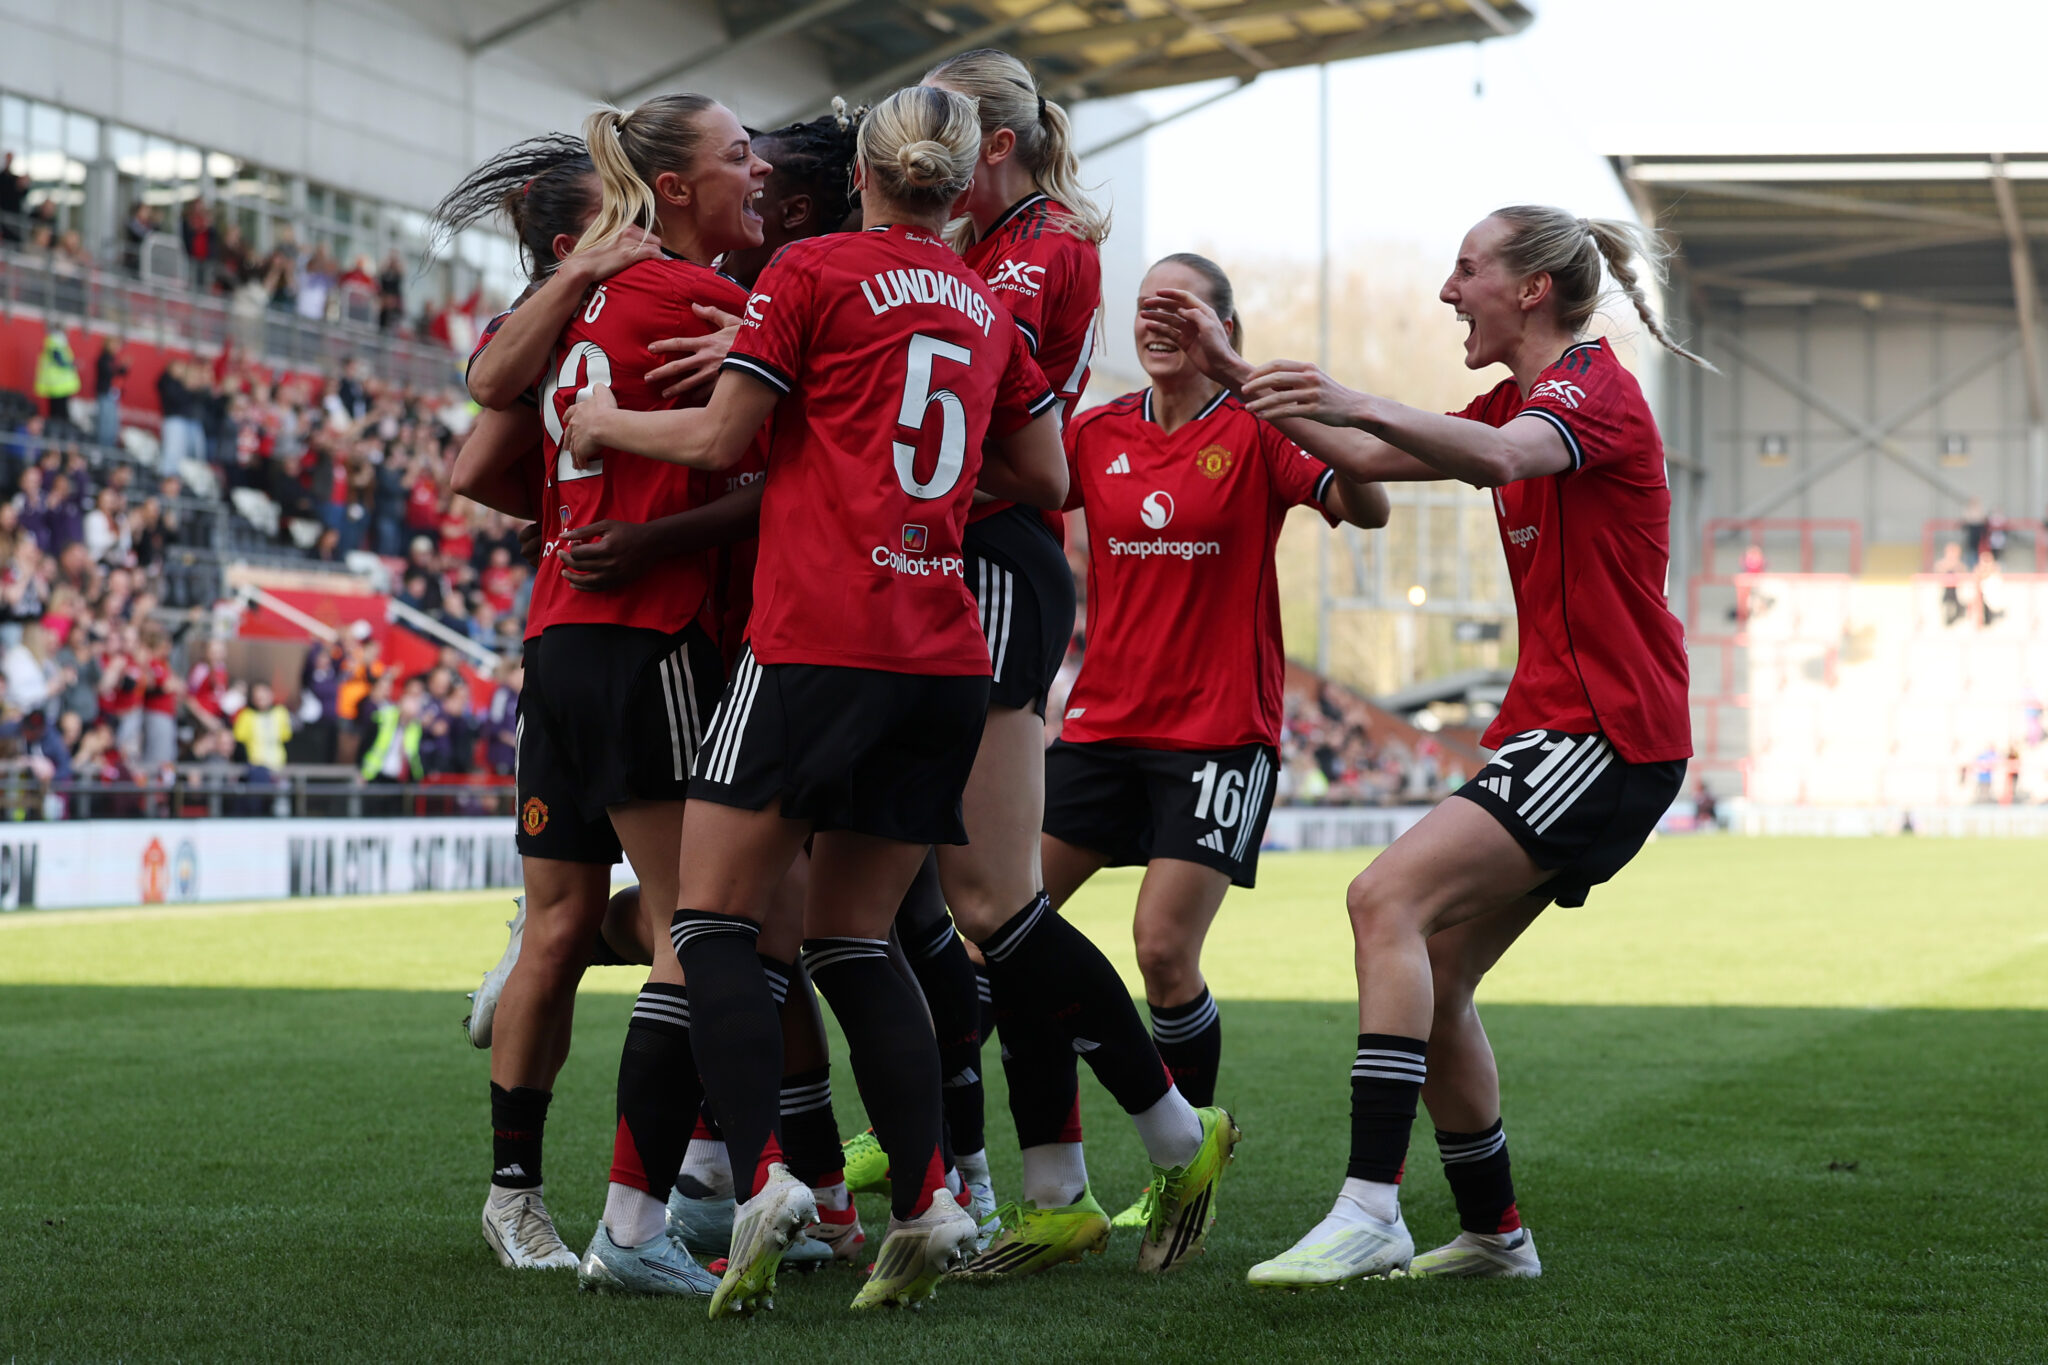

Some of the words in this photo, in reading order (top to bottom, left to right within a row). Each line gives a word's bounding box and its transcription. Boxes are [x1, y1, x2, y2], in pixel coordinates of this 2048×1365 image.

[859, 268, 996, 338] LUNDKVIST
[892, 332, 972, 499] 5
[1107, 536, 1221, 560] Snapdragon
[1487, 728, 1577, 789] 21
[1191, 760, 1245, 828] 16
